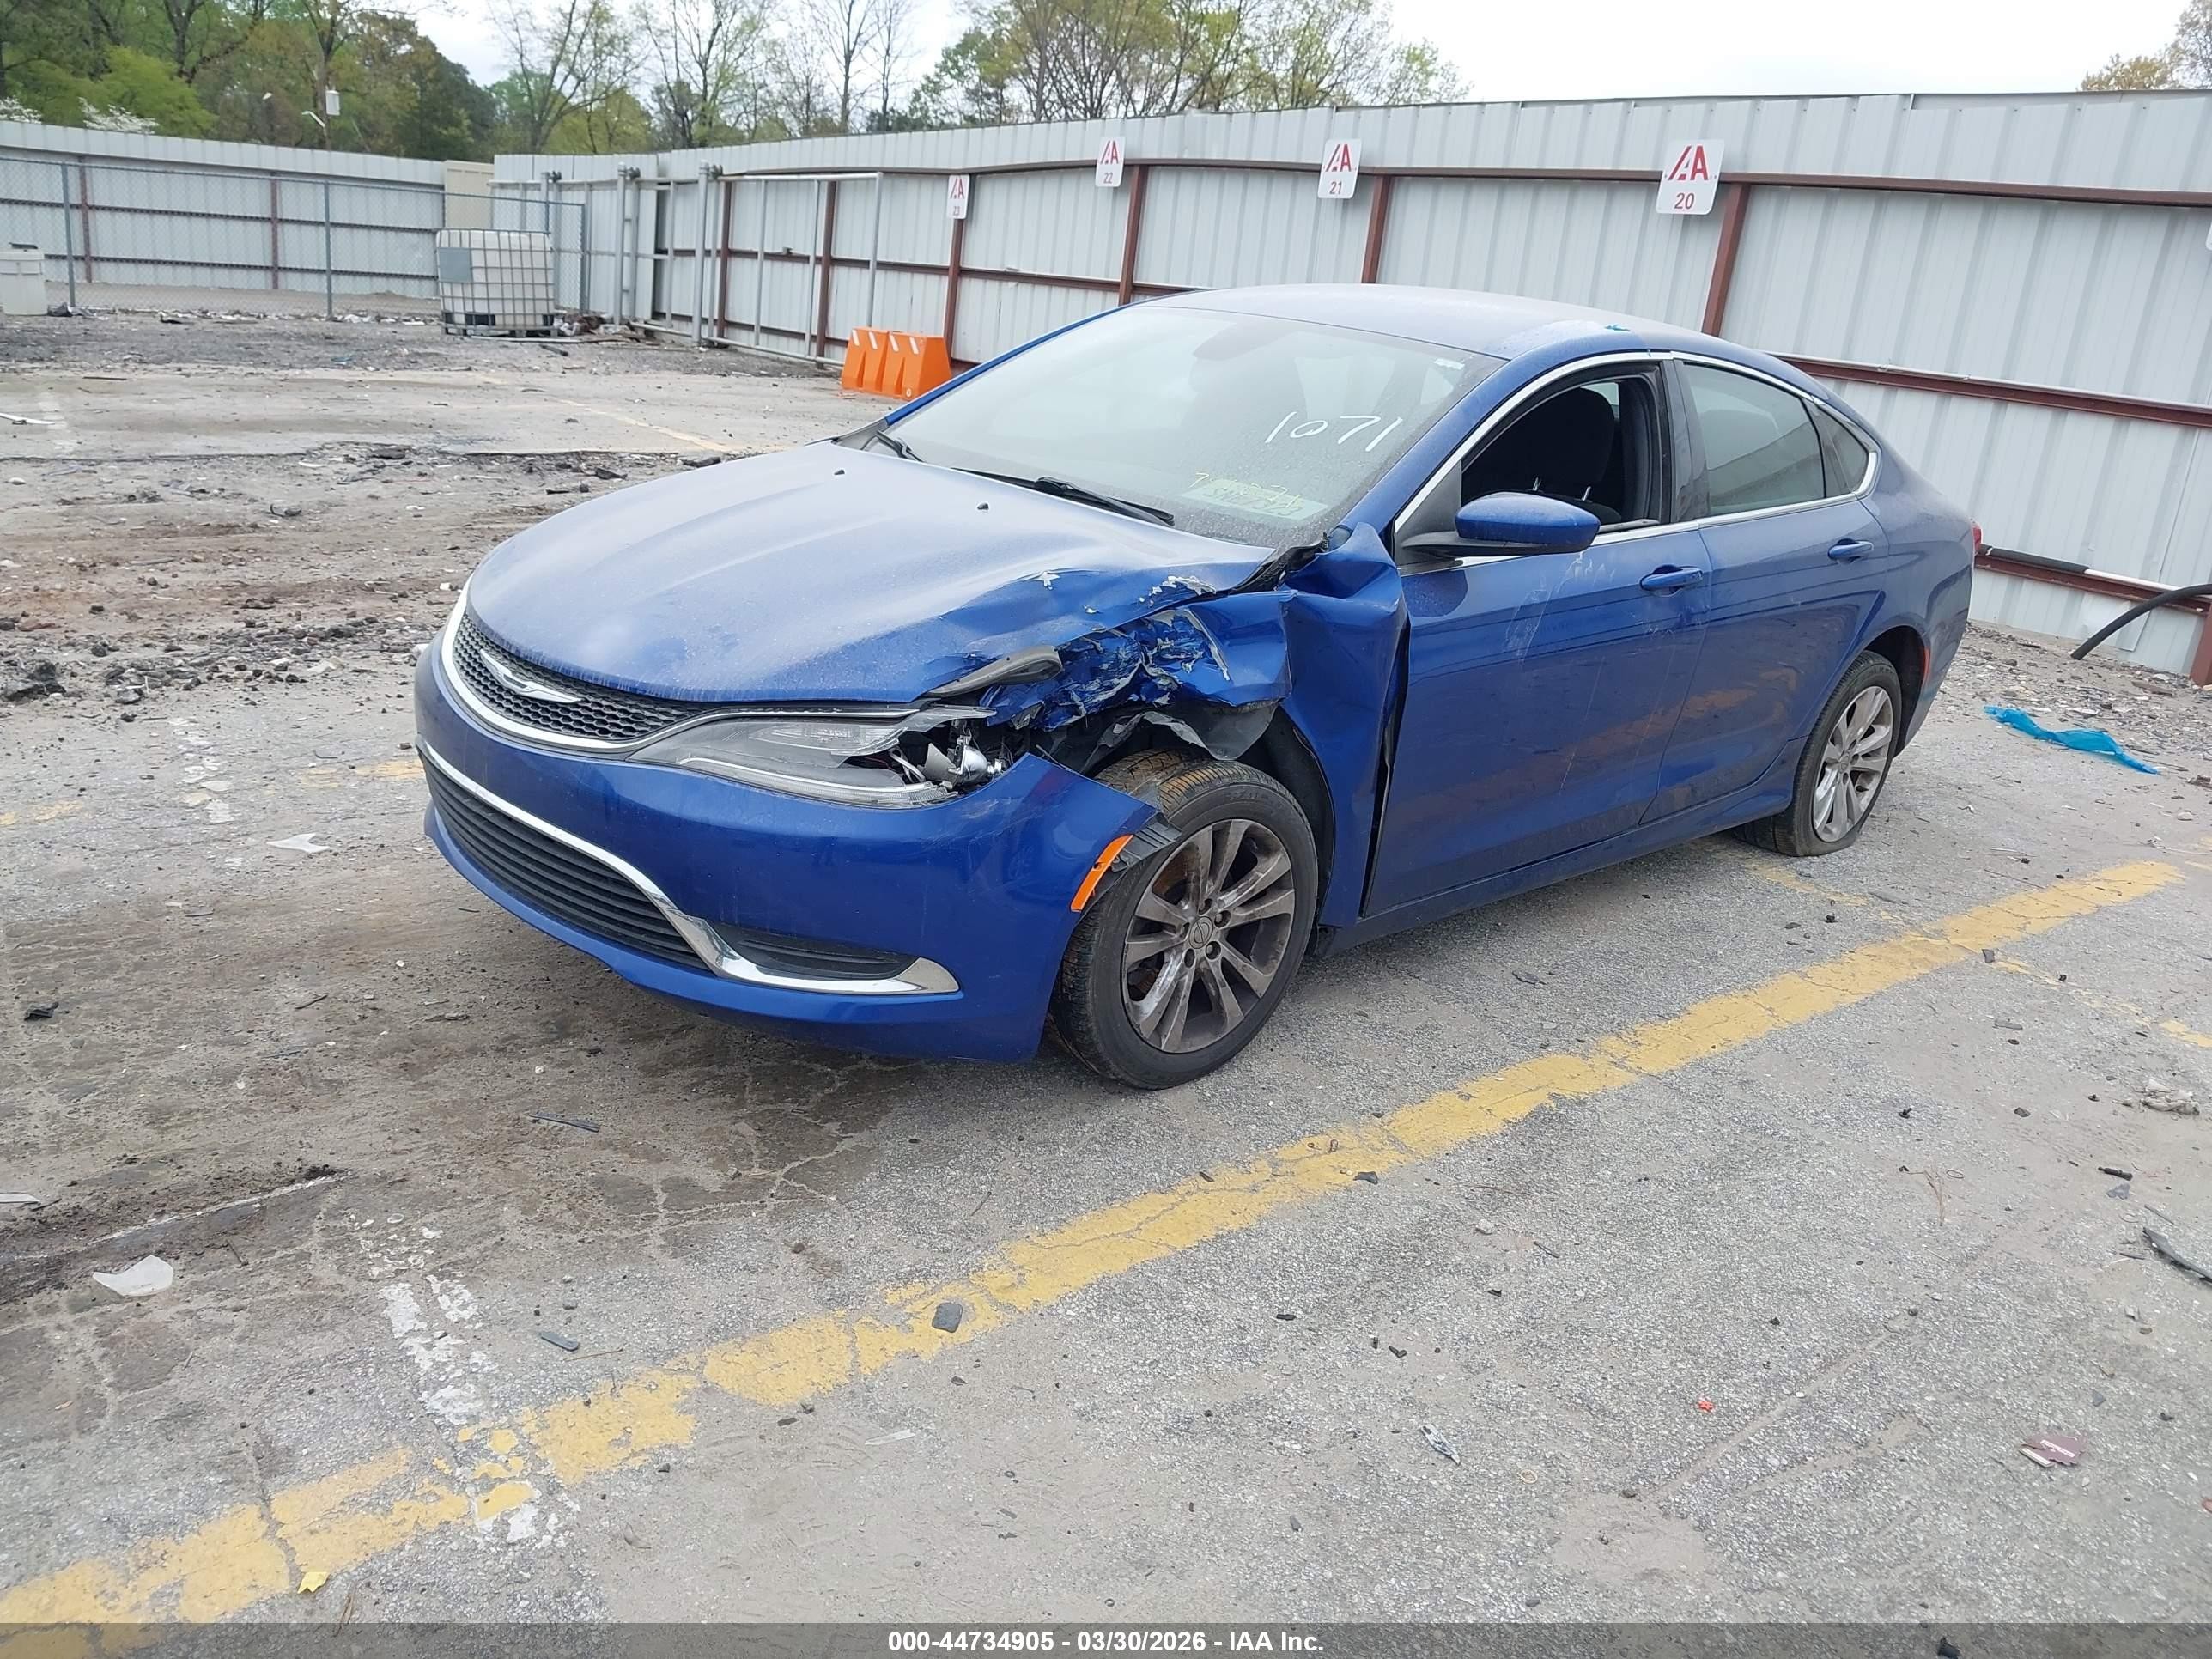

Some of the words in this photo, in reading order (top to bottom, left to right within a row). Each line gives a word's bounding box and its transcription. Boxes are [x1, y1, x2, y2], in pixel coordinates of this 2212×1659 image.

[1103, 172, 1114, 184] 22
[1329, 180, 1342, 195] 21
[1674, 192, 1695, 210] 20
[1265, 411, 1403, 453] 1071
